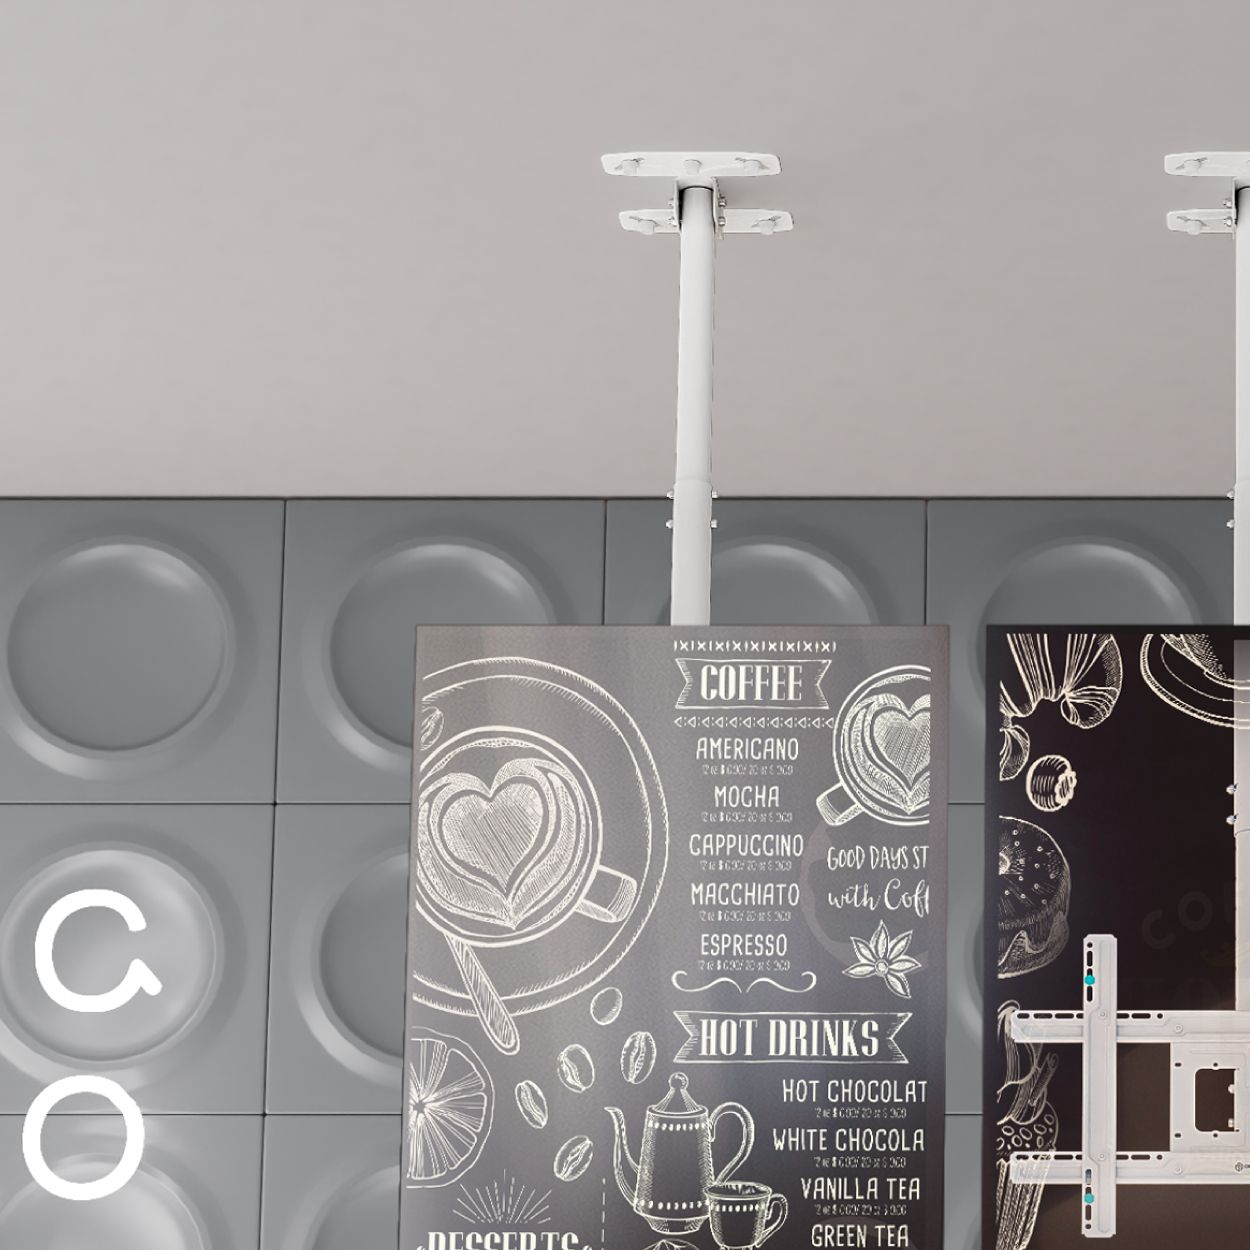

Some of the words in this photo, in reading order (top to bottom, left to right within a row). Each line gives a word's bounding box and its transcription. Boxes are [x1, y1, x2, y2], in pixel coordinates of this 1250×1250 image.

[701, 665, 802, 701] COFFEE
[696, 738, 799, 760] AMERICANO
[714, 785, 780, 807] MOCHA
[689, 834, 804, 857] CAPPUCCINO
[827, 845, 865, 870] GOOD
[870, 845, 908, 870] DAYS
[690, 882, 800, 906] MACCHIATO
[828, 883, 881, 910] with
[701, 934, 787, 956] ESPRESSO
[700, 1019, 758, 1056] HOT
[768, 1019, 879, 1057] DRINKS
[782, 1079, 820, 1103] HOT
[773, 1128, 827, 1151] WHITE
[801, 1178, 878, 1200] VANILLA
[886, 1178, 920, 1200] TEA
[811, 1224, 867, 1248] GREEN
[875, 1224, 909, 1247] TEA
